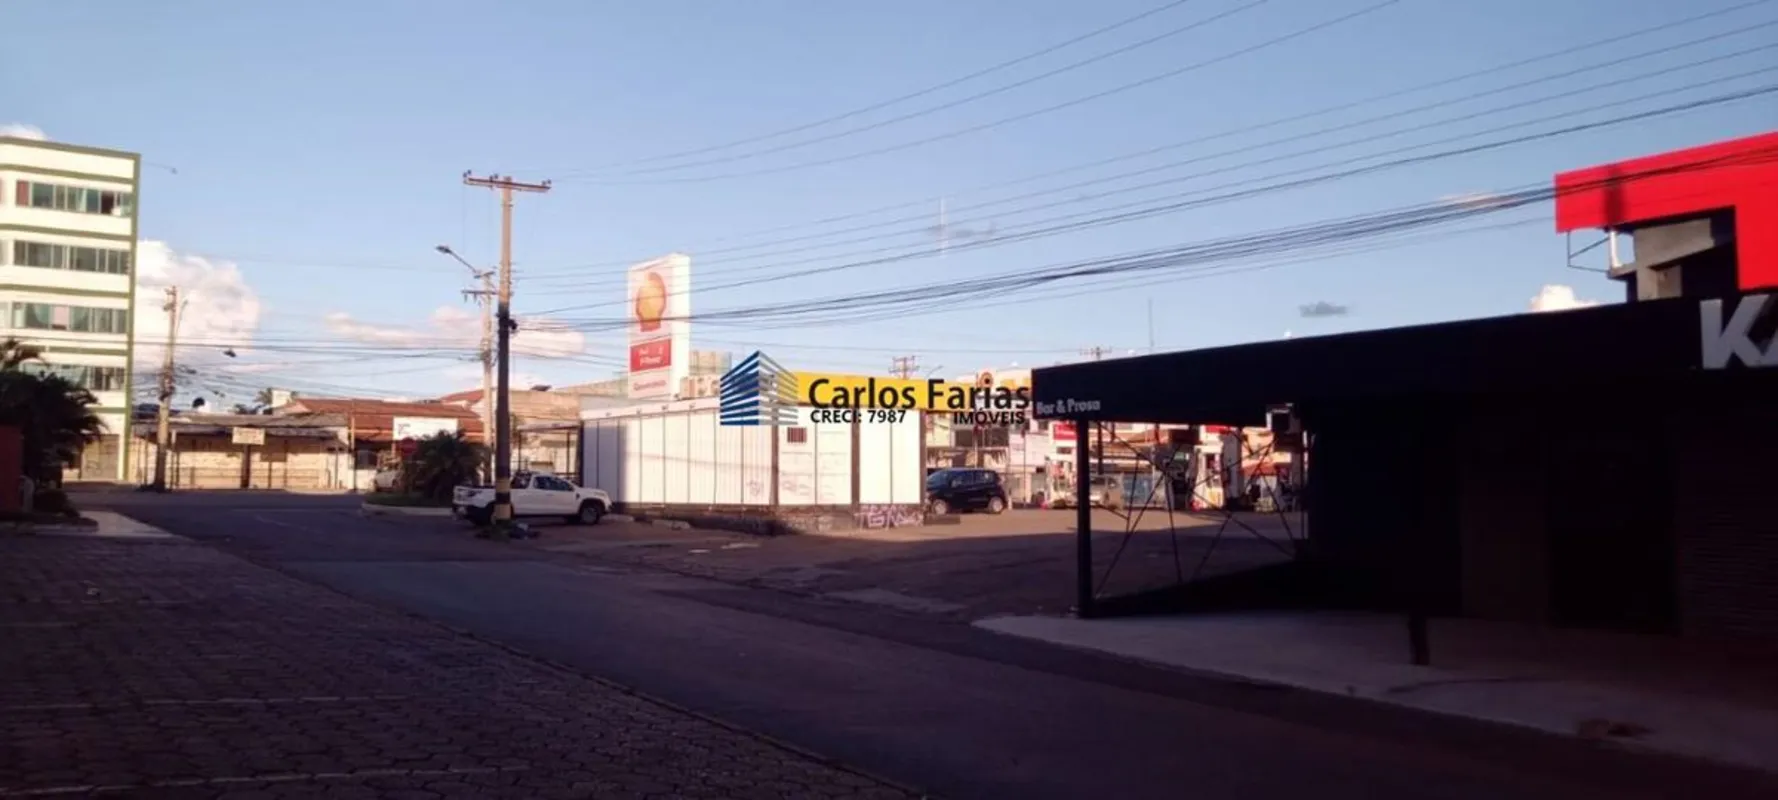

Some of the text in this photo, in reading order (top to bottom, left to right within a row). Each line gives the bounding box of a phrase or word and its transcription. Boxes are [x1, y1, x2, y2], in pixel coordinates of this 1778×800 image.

[1700, 294, 1778, 369] K
[1036, 398, 1101, 415] Bar & Prosa
